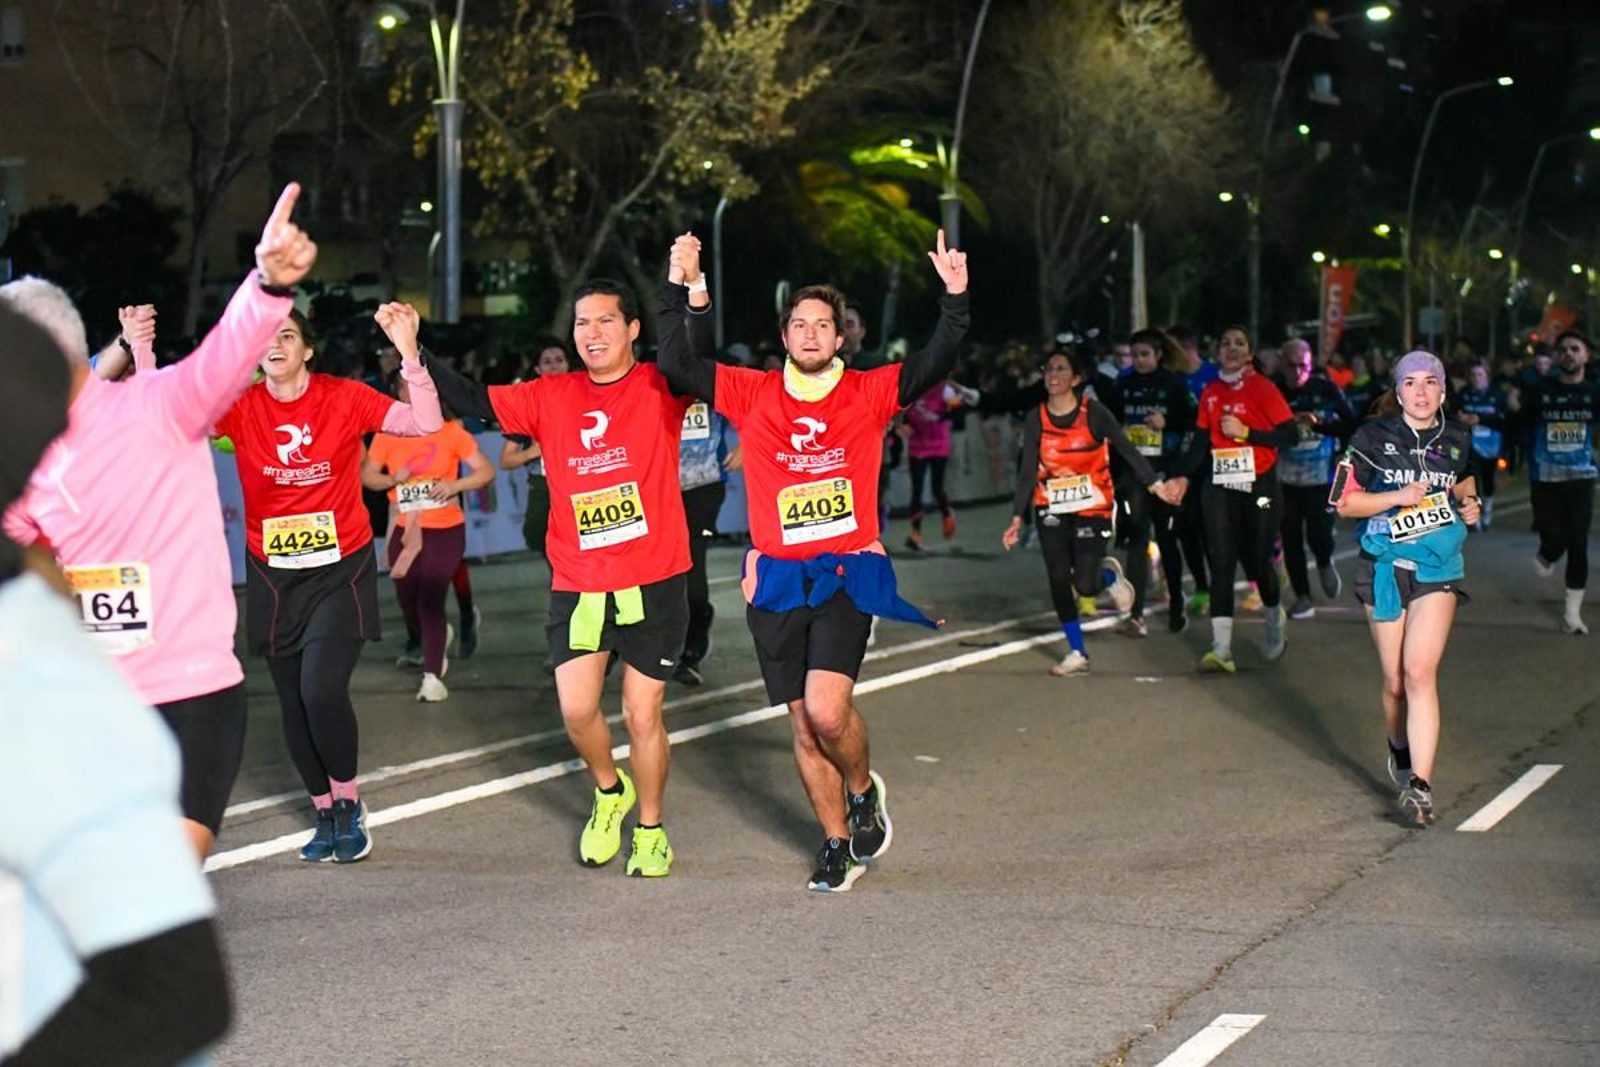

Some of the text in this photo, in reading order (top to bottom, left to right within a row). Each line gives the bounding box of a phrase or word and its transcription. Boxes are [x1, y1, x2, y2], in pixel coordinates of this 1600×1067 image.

[567, 446, 627, 468] #maeaPR
[776, 447, 846, 465] #mareaPR
[263, 461, 332, 478] #mareaPR
[1383, 469, 1415, 484] SAN
[1052, 484, 1088, 502] 7770
[580, 500, 635, 528] 4409
[787, 495, 846, 521] 4403
[1393, 507, 1451, 531] 10156
[269, 529, 330, 551] 4429
